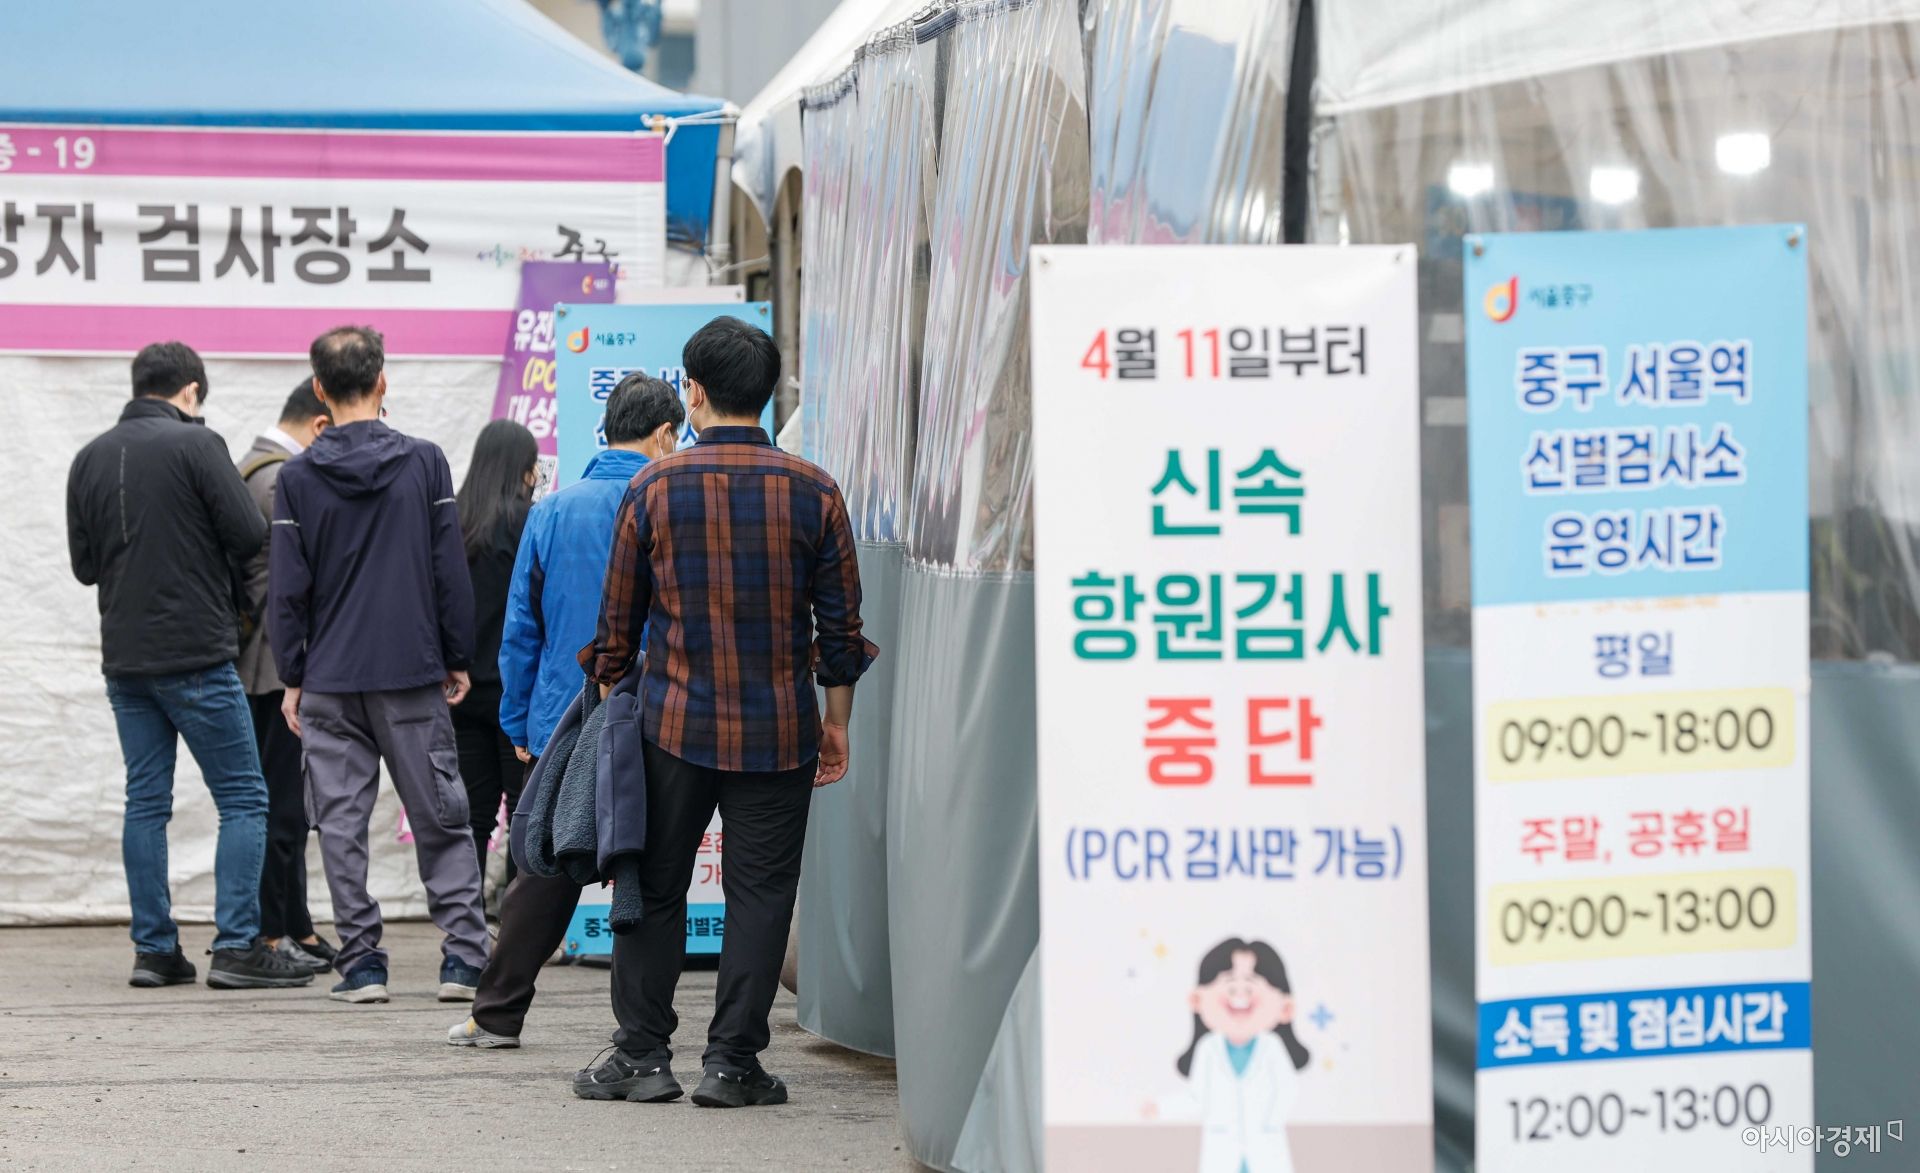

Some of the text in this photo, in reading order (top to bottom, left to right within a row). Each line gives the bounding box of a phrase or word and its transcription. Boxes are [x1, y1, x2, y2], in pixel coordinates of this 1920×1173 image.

[139, 206, 432, 284] 검사장소
[1081, 326, 1366, 380] 4월 11일부터
[1522, 344, 1748, 407] 중구 서울역
[1528, 429, 1742, 489] 선별검사소
[1150, 448, 1305, 537] 신속
[1549, 511, 1720, 571] 운영시간
[1071, 572, 1391, 660] 항원검사
[1595, 632, 1674, 679] 평일
[1500, 707, 1775, 763] 09:00~18:00
[1066, 827, 1404, 881] (PCR 검사만 가능)
[1521, 807, 1751, 863] 주말, 공휴일
[1501, 886, 1777, 944] 09:00~13:00
[1494, 990, 1789, 1058] 소독 및 점심시간
[1508, 1083, 1773, 1143] 12:00~13:00
